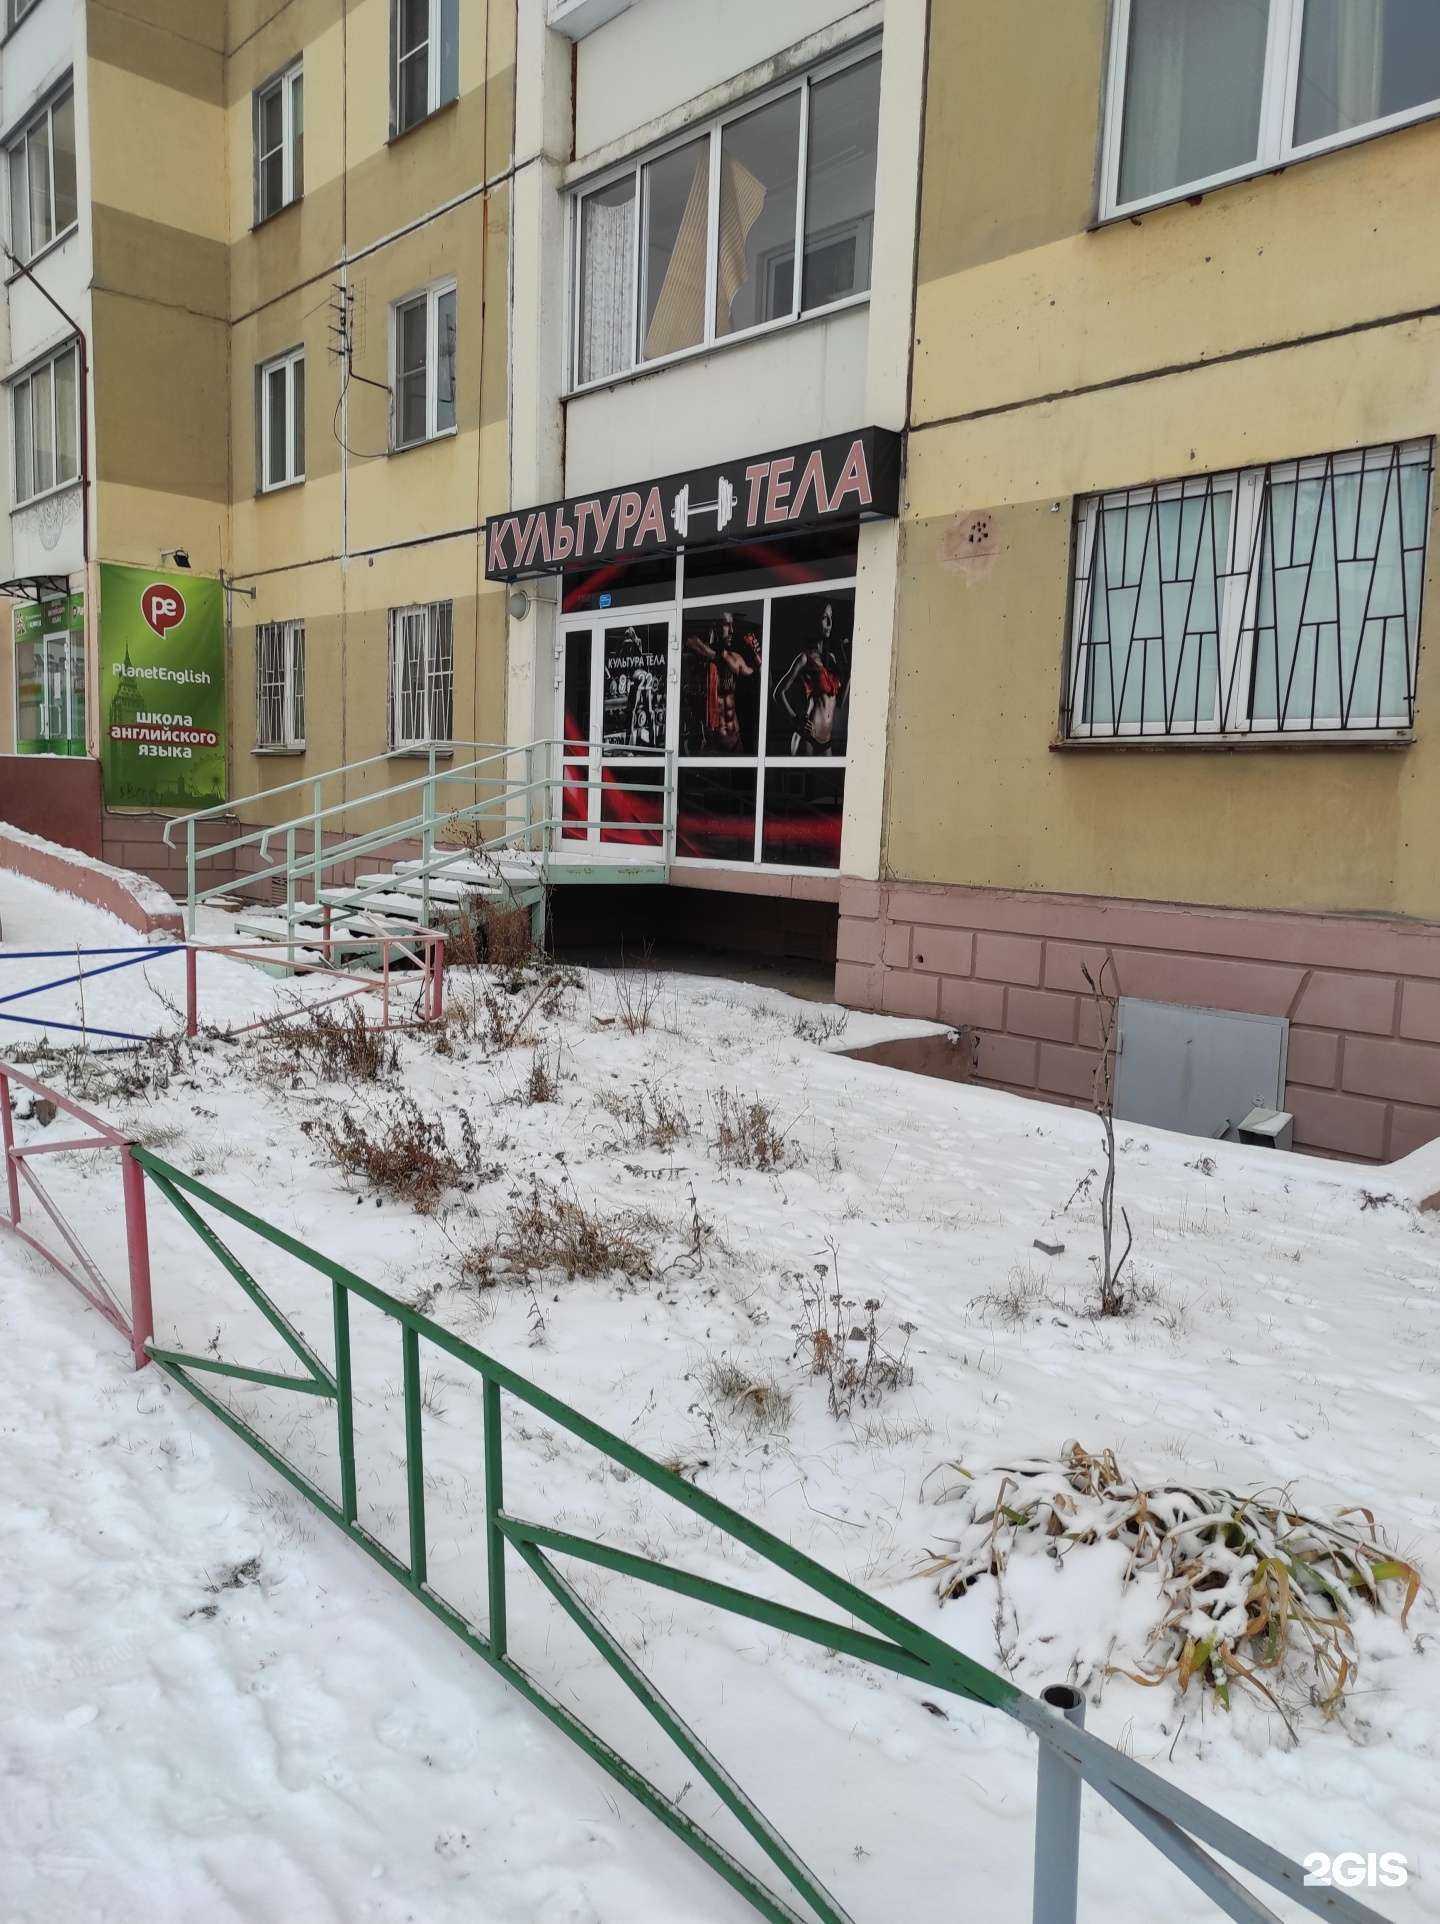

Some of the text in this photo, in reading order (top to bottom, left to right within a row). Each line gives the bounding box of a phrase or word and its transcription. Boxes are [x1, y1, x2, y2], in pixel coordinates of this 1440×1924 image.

[487, 439, 873, 572] КУЛЬТУРА ТЕЛА
[608, 653, 666, 669] КУЛЬТУРА ТЕЛА
[112, 662, 211, 685] PlanetEnglish
[136, 710, 193, 727] школа
[111, 725, 217, 745] английского
[138, 744, 193, 759] языка
